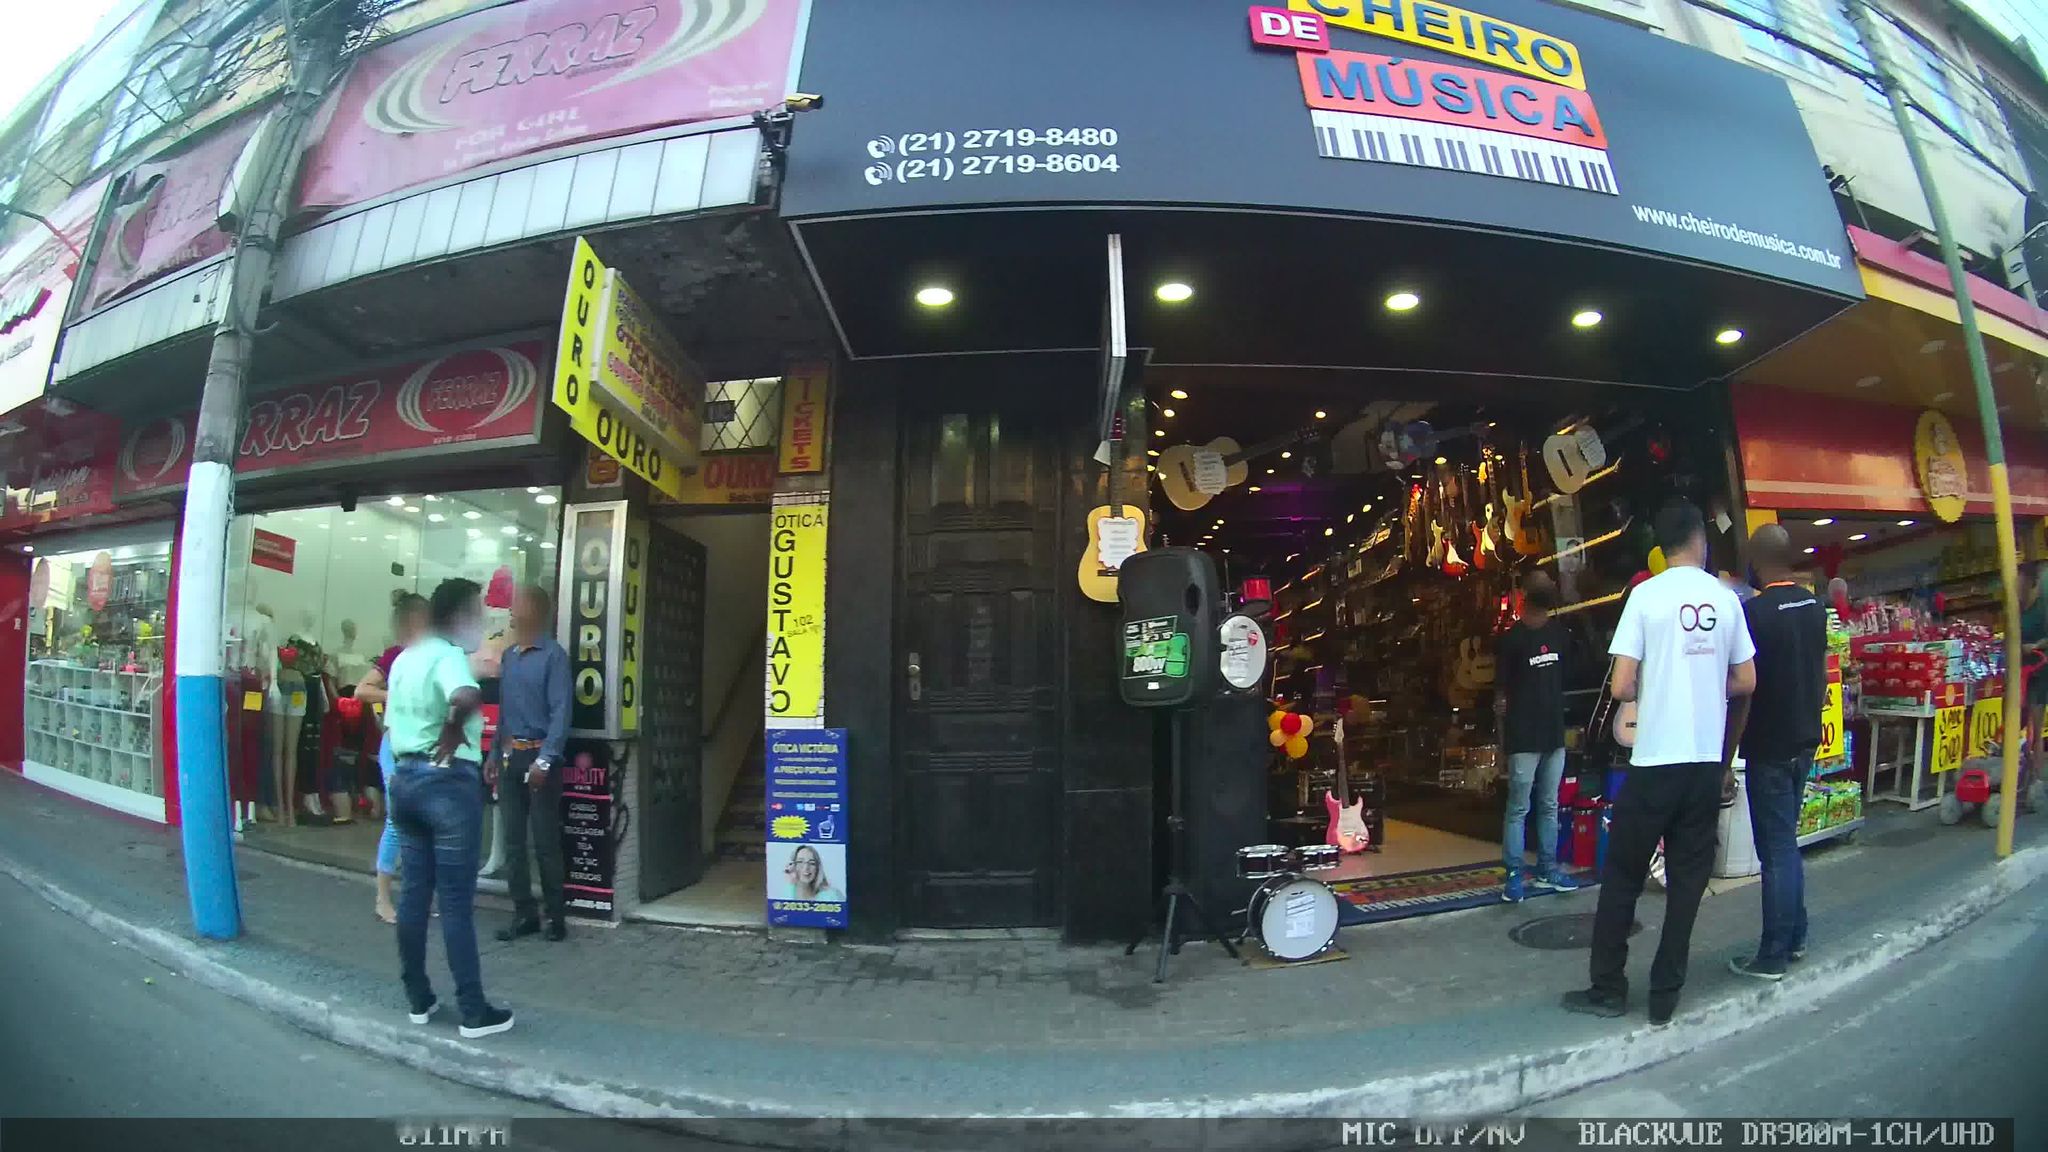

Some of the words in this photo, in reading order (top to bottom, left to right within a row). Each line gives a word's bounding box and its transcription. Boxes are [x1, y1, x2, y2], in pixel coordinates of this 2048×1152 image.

[439, 3, 658, 104] FERRAZ
[1261, 12, 1321, 41] DE
[1314, 57, 1596, 137] MÚSICA
[896, 157, 954, 183] (21)
[962, 153, 1120, 175] 2719-8604
[898, 131, 956, 156] (21)
[963, 127, 1118, 149] 2719-8480
[1631, 204, 1842, 270] www.cheirodemusica.com.br
[566, 259, 595, 406] OURO
[240, 379, 382, 457] RRAZ
[597, 408, 662, 482] OURO
[576, 537, 610, 706] OURO
[621, 536, 639, 709] OURO
[769, 529, 797, 713] GUSTAVO
[1680, 603, 1717, 632] OG
